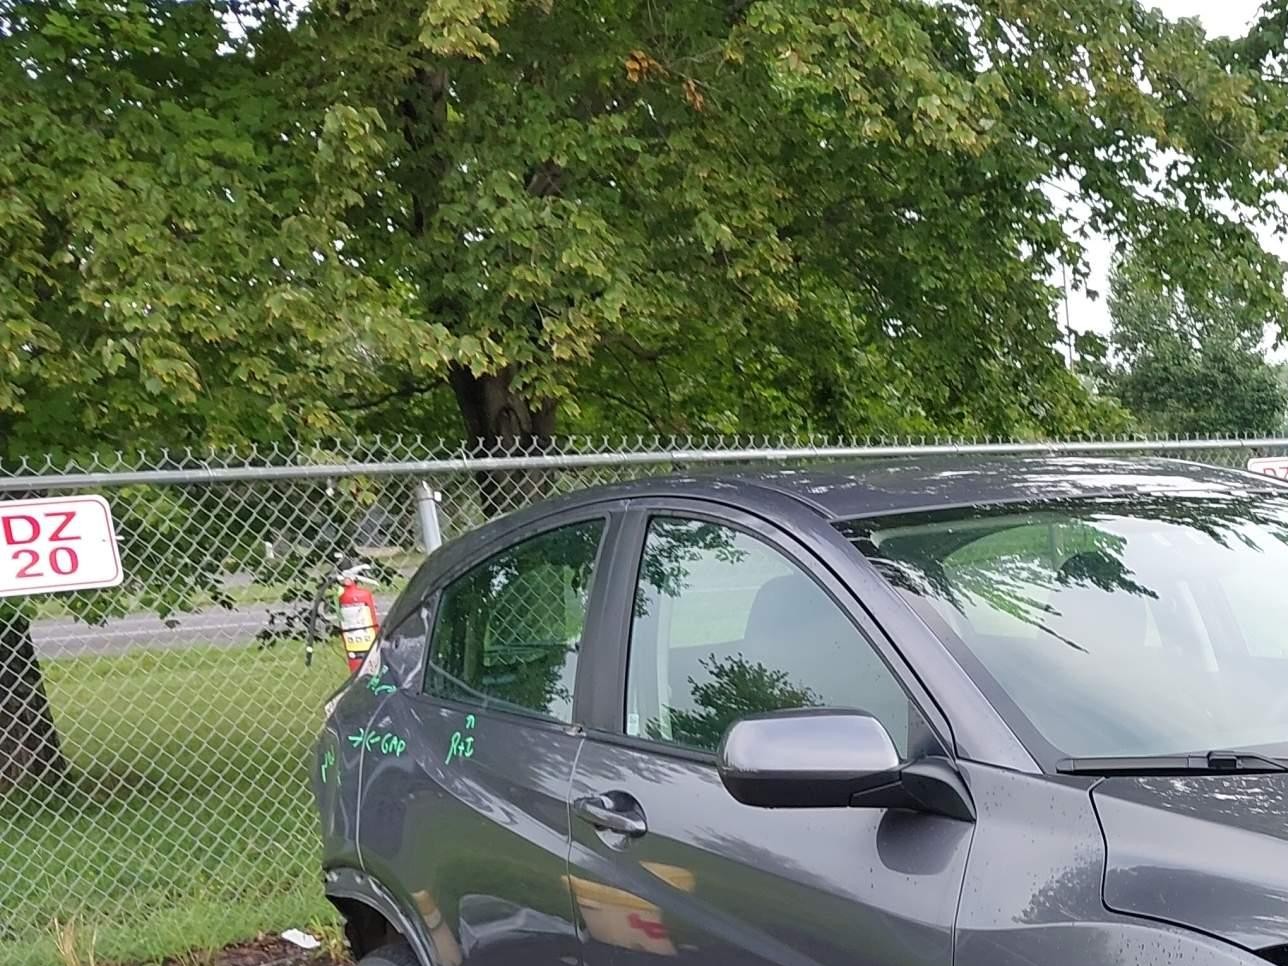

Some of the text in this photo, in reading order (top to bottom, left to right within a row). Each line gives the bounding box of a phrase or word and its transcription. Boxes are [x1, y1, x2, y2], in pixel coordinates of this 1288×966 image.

[2, 511, 81, 545] DZ
[12, 547, 79, 578] 20
[381, 732, 406, 757] GAP
